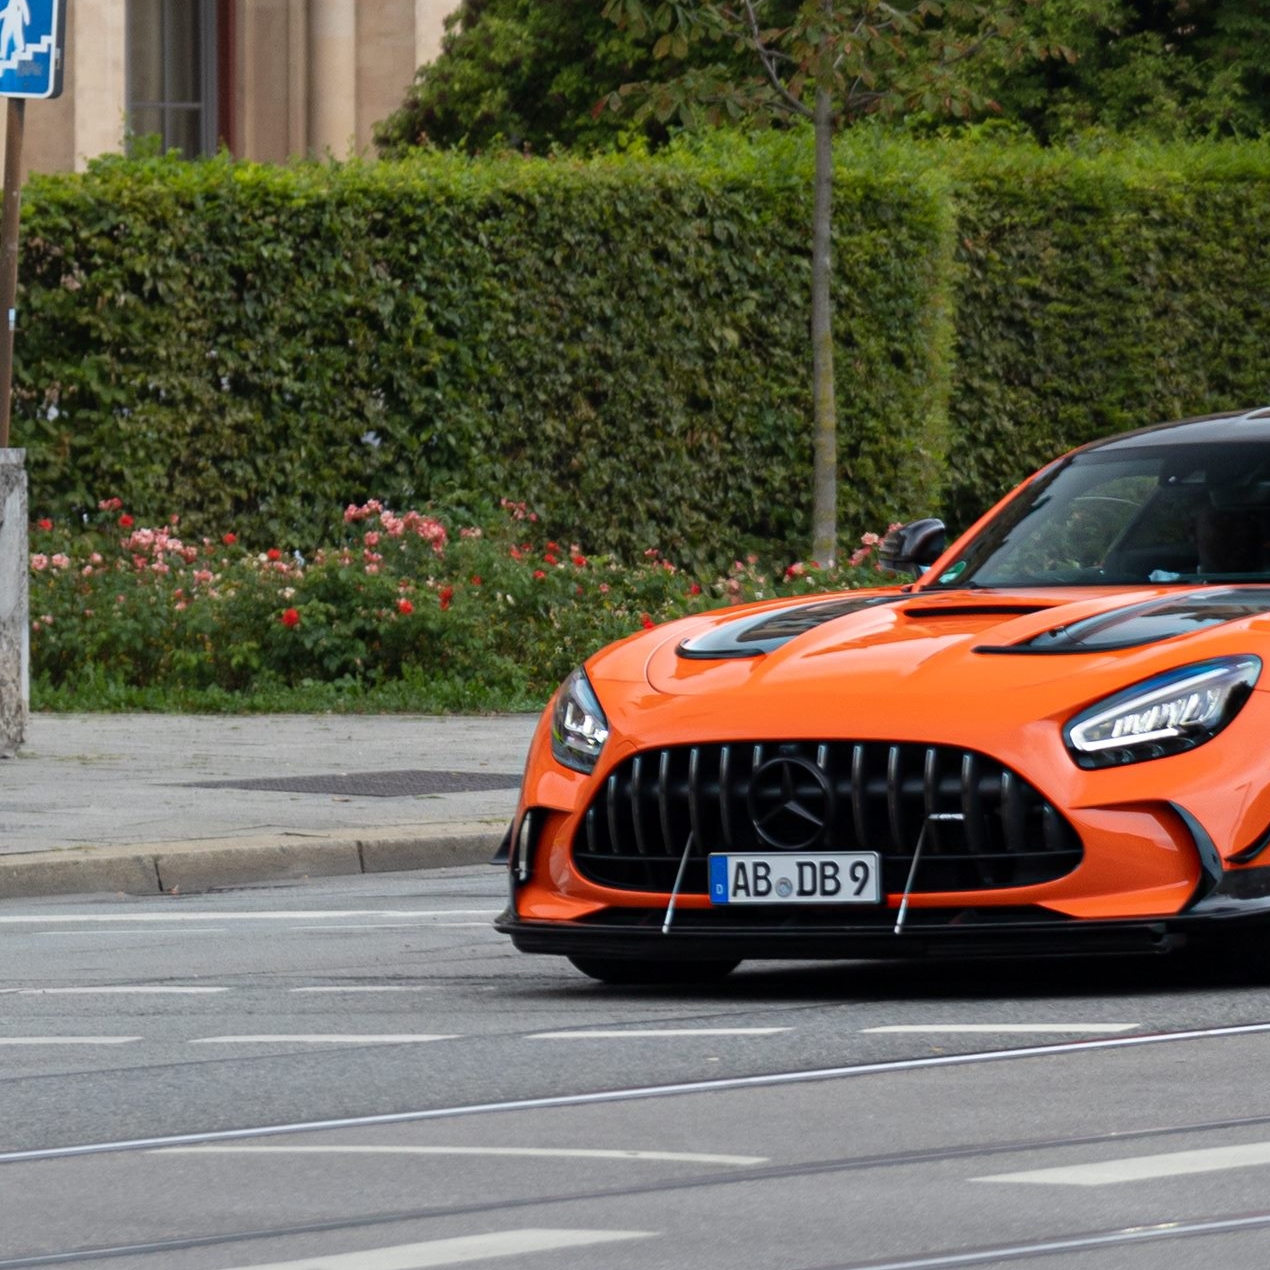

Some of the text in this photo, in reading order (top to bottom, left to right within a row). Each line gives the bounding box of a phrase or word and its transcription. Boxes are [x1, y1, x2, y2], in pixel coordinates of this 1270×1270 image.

[715, 883, 724, 895] D
[731, 860, 870, 897] AB DB 9
